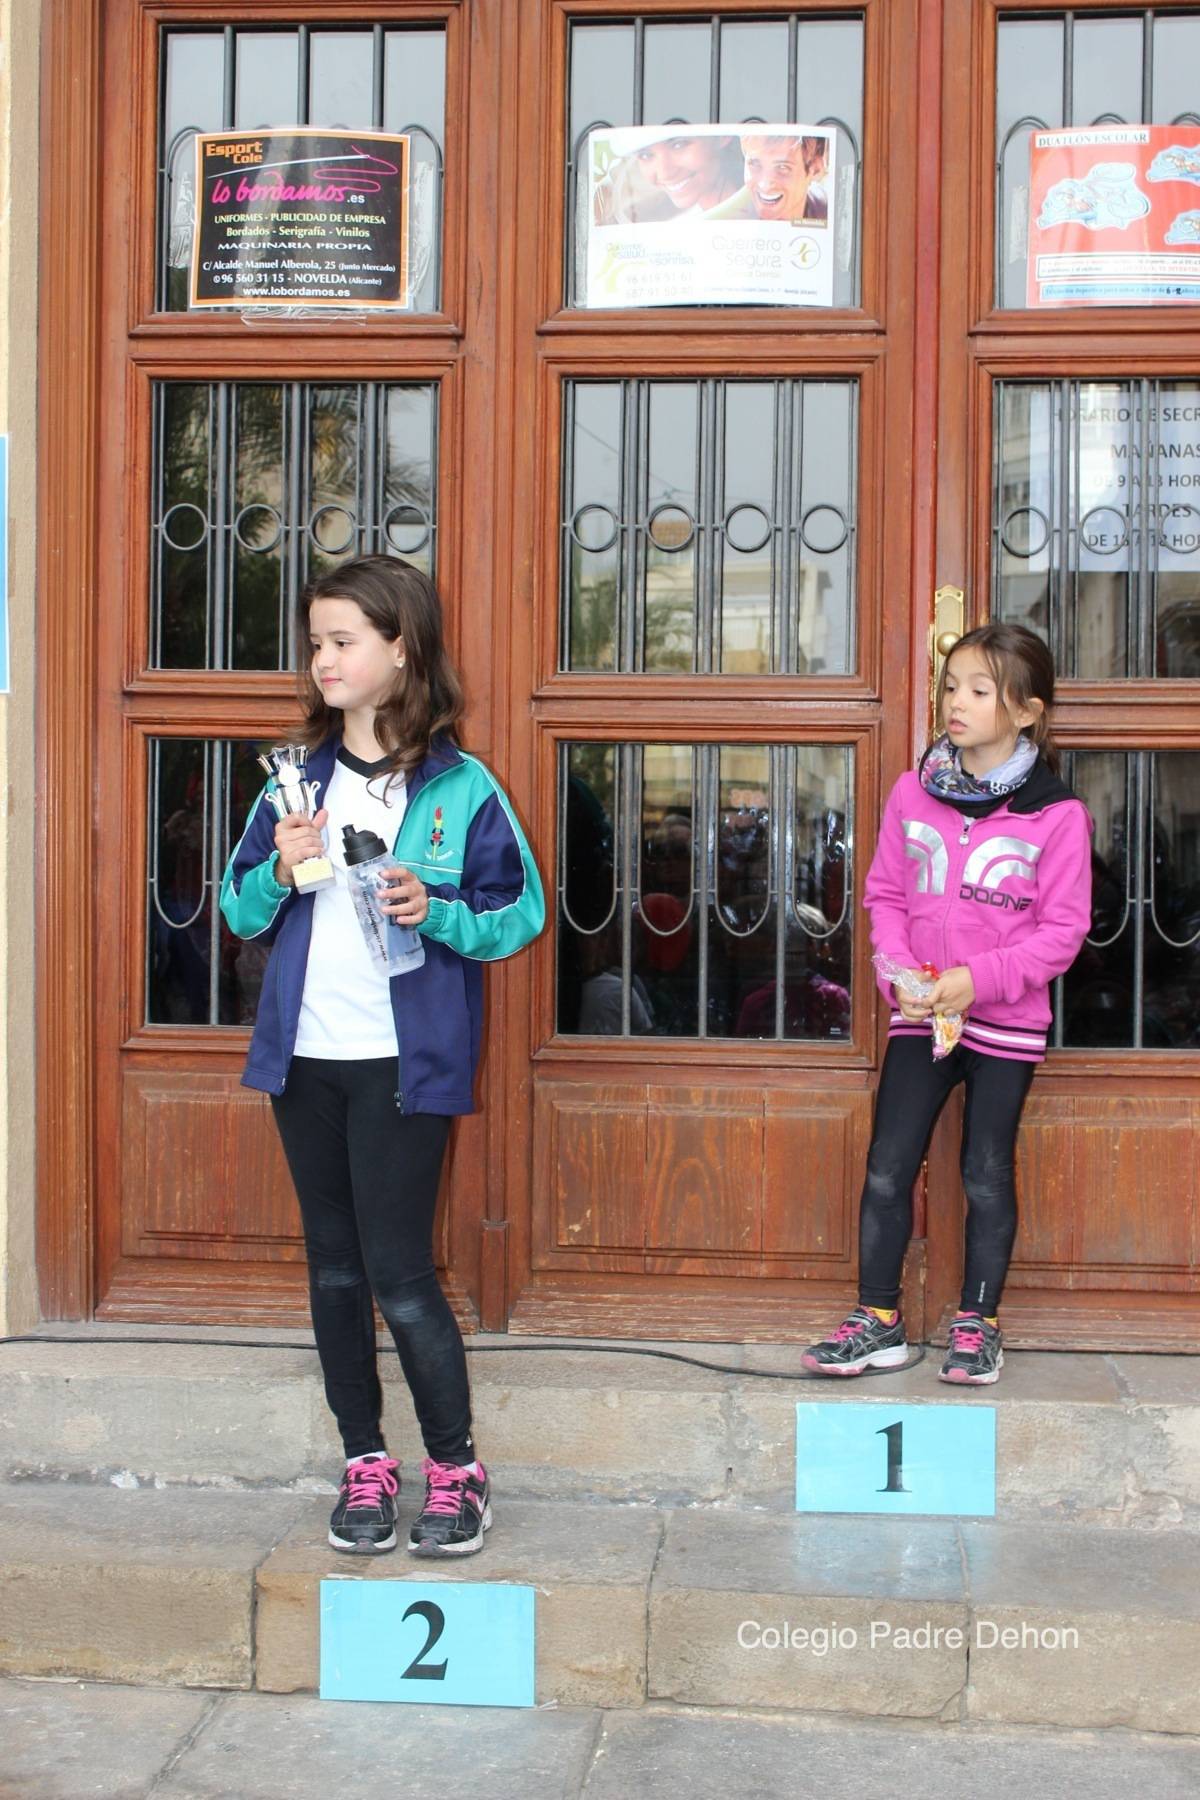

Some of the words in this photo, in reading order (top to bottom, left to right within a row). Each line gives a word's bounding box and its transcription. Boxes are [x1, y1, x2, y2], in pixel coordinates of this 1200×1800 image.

[206, 141, 263, 158] Esport
[233, 153, 263, 164] Cole
[212, 179, 231, 204] lo
[214, 213, 263, 224] UNIFORMES
[271, 212, 327, 222] PUBLICIDAD
[329, 213, 343, 223] DE
[344, 213, 387, 225] EMPRESA
[226, 225, 270, 237] Bordados
[335, 226, 371, 238] Vinilos
[217, 241, 312, 251] MAQUINARIA
[316, 242, 373, 252] PROPIA
[213, 260, 243, 270] Alcalde
[244, 259, 279, 269] Manuel
[324, 261, 336, 270] 25
[235, 273, 254, 284] 560
[256, 273, 268, 283] 31
[272, 273, 285, 283] 15
[294, 272, 348, 284] NOVELDA
[243, 286, 351, 297] www.lobordamos.es
[1088, 534, 1108, 547] DE
[959, 884, 1033, 912] DOONE
[875, 1420, 913, 1493] 1
[400, 1599, 449, 1681] 2
